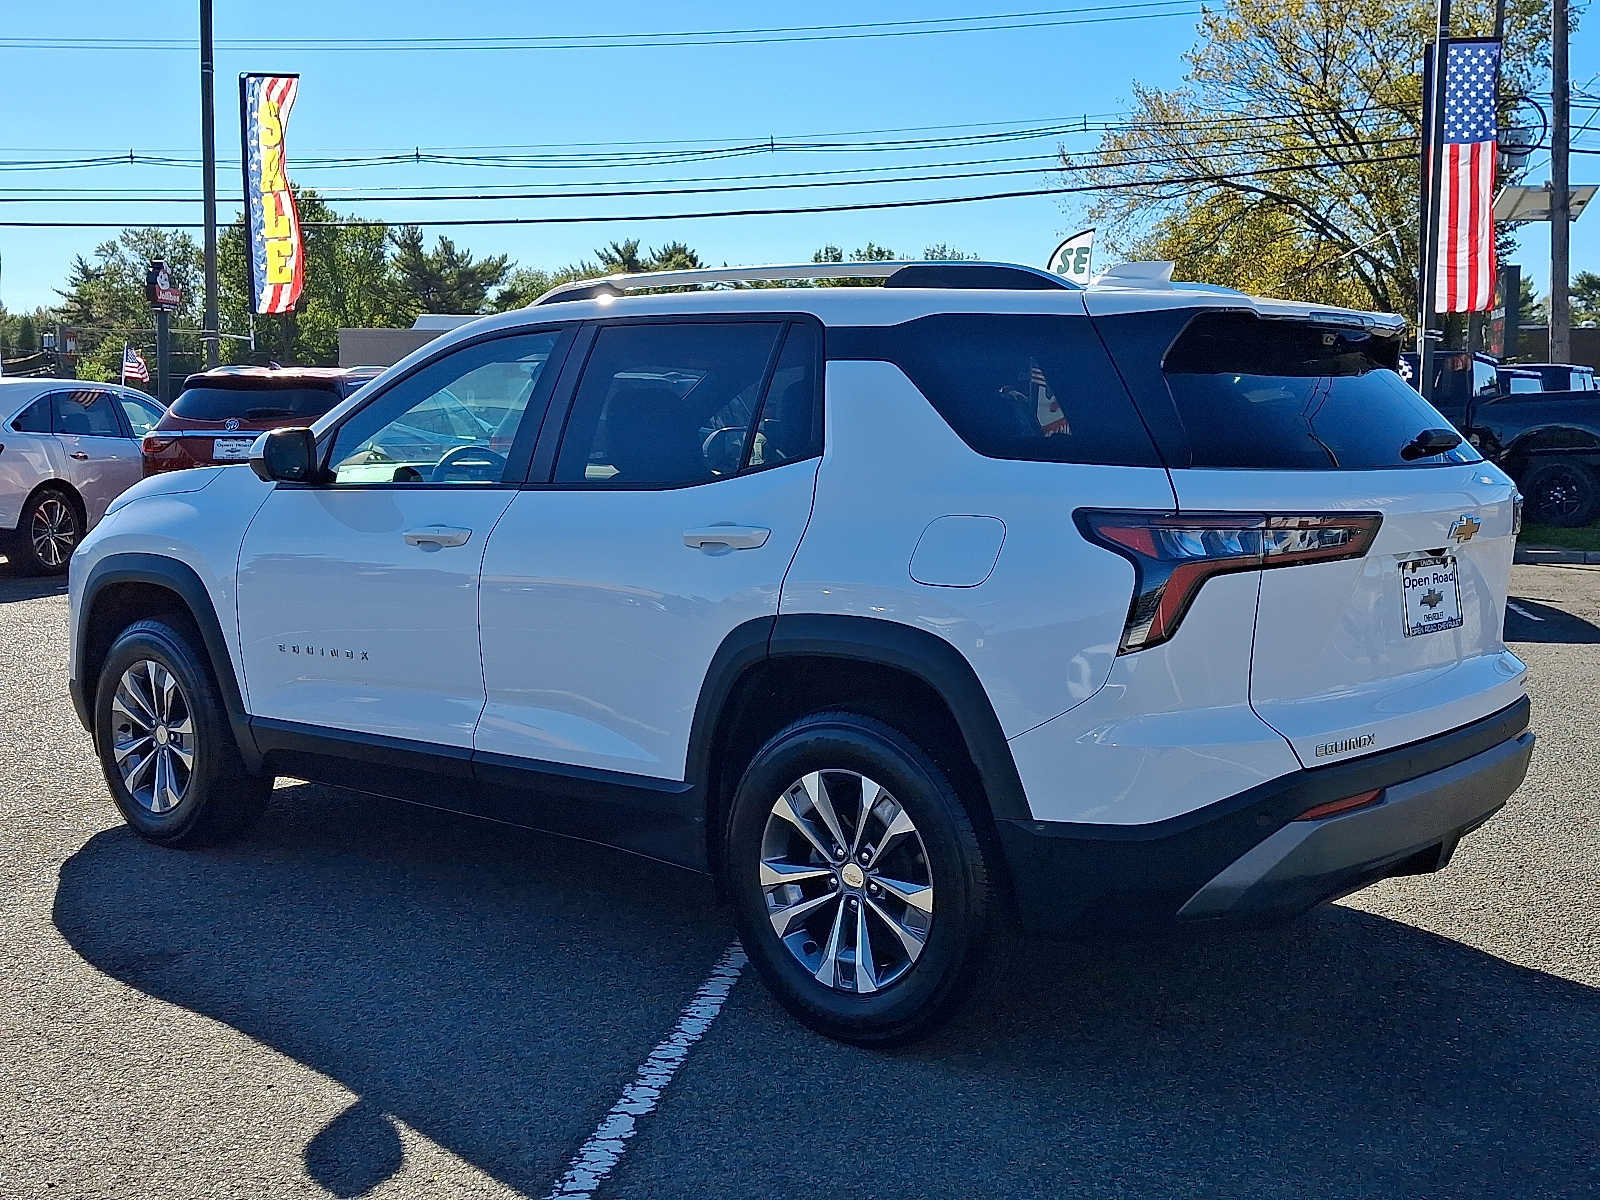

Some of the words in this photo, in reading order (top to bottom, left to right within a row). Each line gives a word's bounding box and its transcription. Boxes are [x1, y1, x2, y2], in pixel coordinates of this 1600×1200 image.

[258, 100, 293, 285] SALE
[1403, 576, 1430, 590] Open
[1432, 570, 1454, 585] Road
[278, 643, 369, 661] EQUINOX
[1315, 733, 1376, 757] EQUINOX
